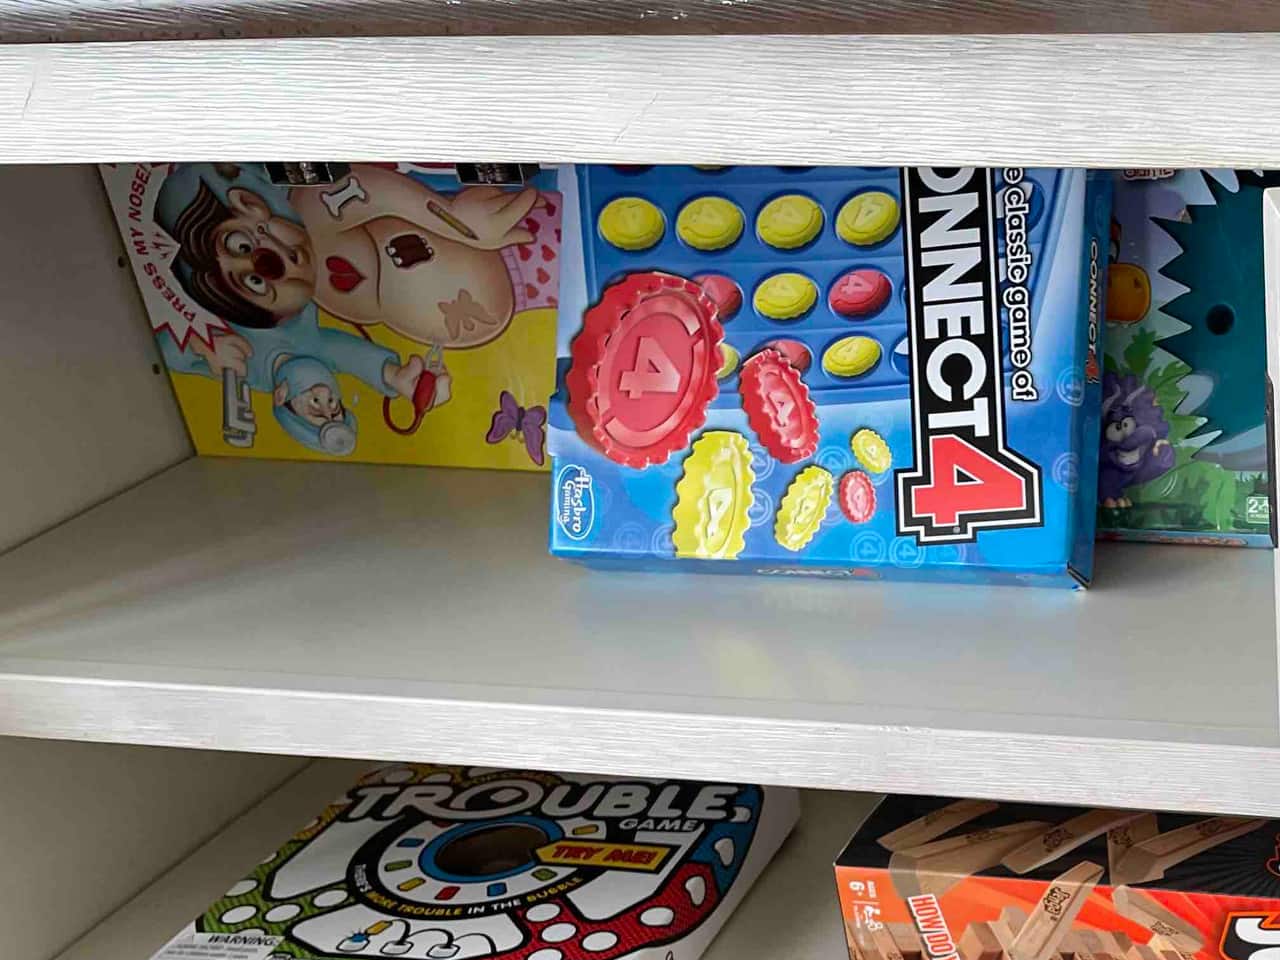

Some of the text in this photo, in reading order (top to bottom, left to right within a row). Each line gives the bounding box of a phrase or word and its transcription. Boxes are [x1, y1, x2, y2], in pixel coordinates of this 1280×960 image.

[129, 227, 150, 257] MY
[143, 262, 197, 322] PRESS
[1004, 186, 1038, 401] classic game of
[1088, 236, 1100, 353] CONNECT
[911, 432, 1027, 526] 4
[562, 480, 576, 524] Gaming
[572, 475, 590, 533] Hasbro
[347, 780, 740, 822] TROUBLE
[619, 818, 699, 832] GAME
[552, 845, 658, 865] TRY ME!
[397, 876, 584, 918] TROUBLE IN THE BUBBLE
[912, 895, 945, 932] HOW
[927, 932, 955, 956] DO
